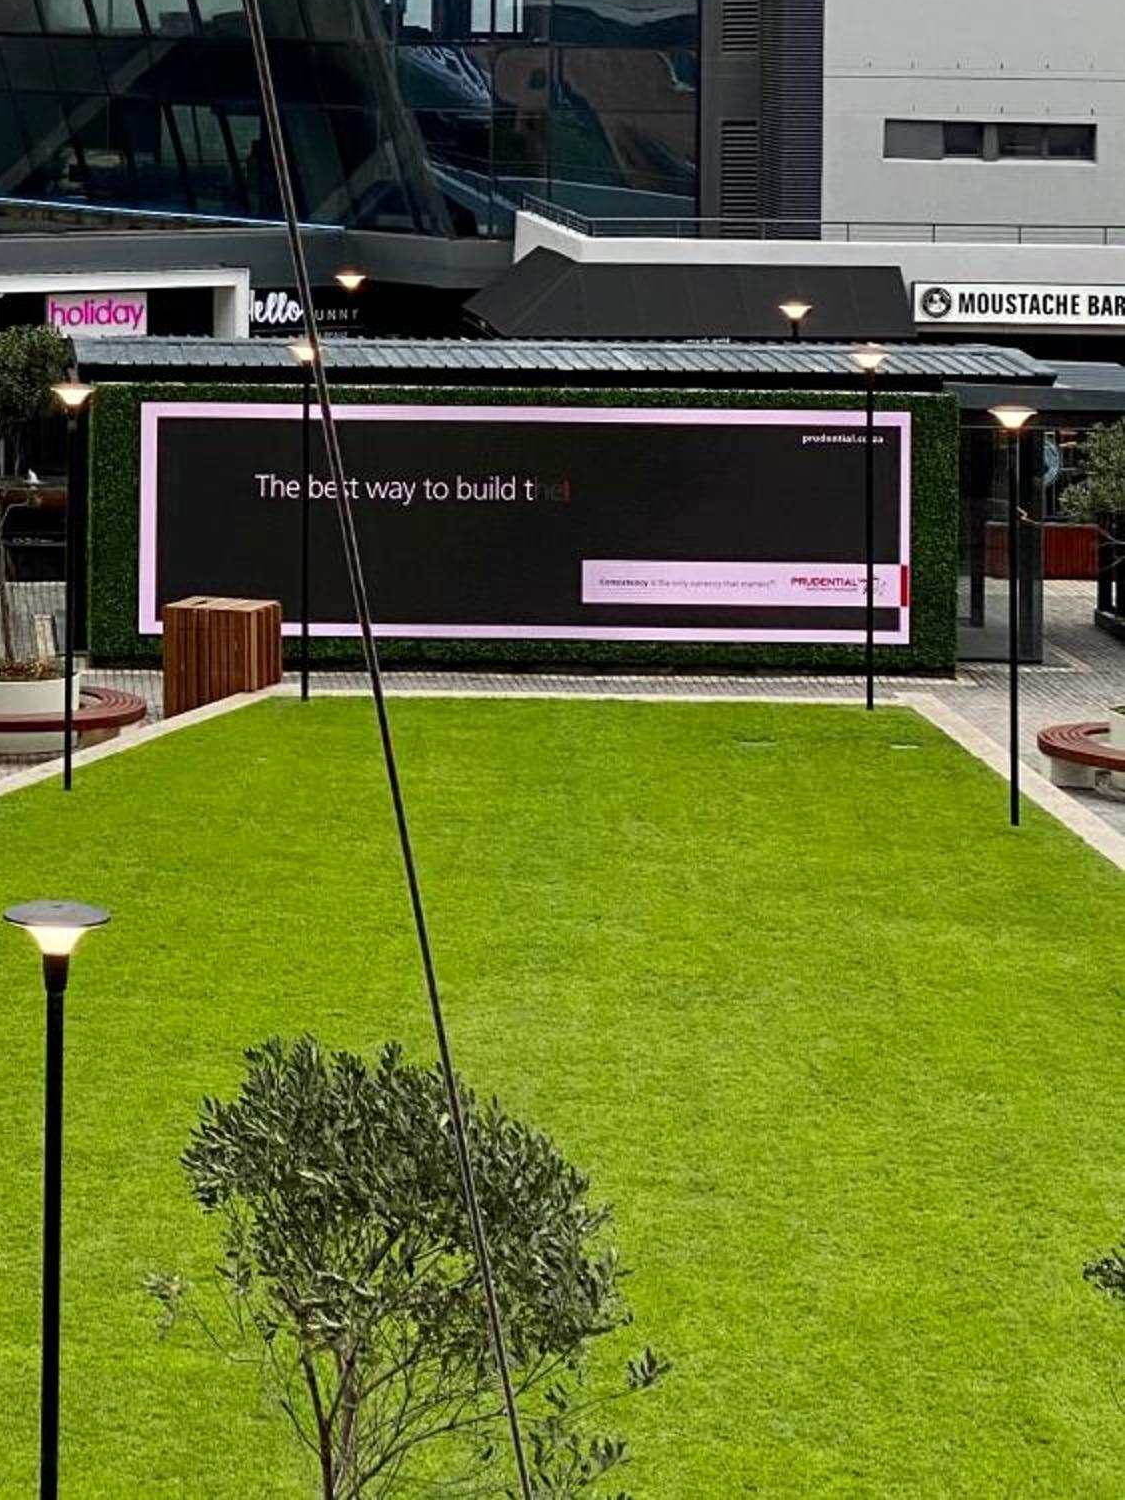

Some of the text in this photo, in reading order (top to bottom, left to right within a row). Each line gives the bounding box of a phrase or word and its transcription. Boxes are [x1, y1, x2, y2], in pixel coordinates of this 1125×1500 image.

[49, 298, 145, 330] holiday
[958, 293, 1081, 316] MOUSTACHE
[254, 474, 300, 499] The
[365, 479, 416, 505] way
[424, 477, 450, 500] to
[456, 475, 517, 501] build
[791, 577, 858, 587] PRUDENTIAL
